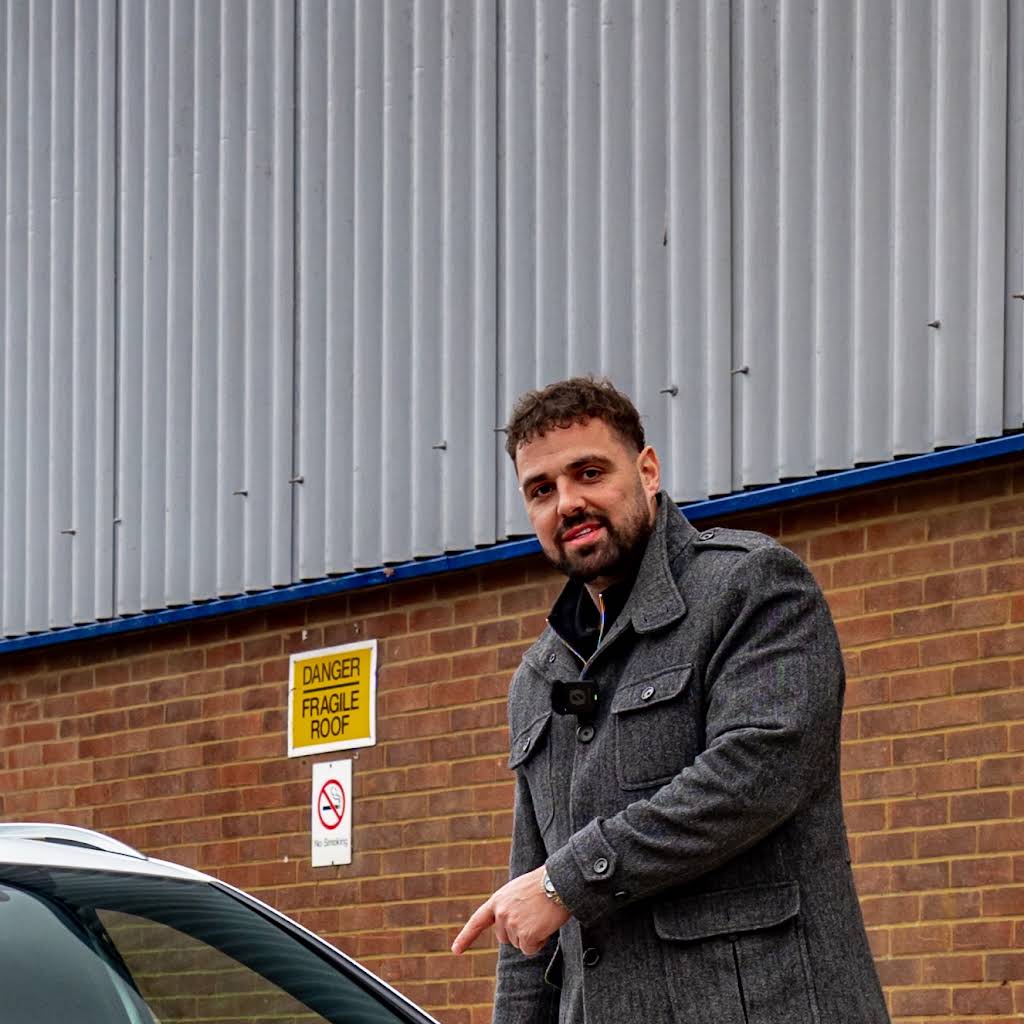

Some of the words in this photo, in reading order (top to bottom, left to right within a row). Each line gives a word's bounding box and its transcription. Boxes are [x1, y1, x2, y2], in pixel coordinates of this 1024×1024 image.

[303, 657, 361, 686] DANGER
[302, 690, 360, 718] FRAGILE
[310, 715, 350, 740] ROOF
